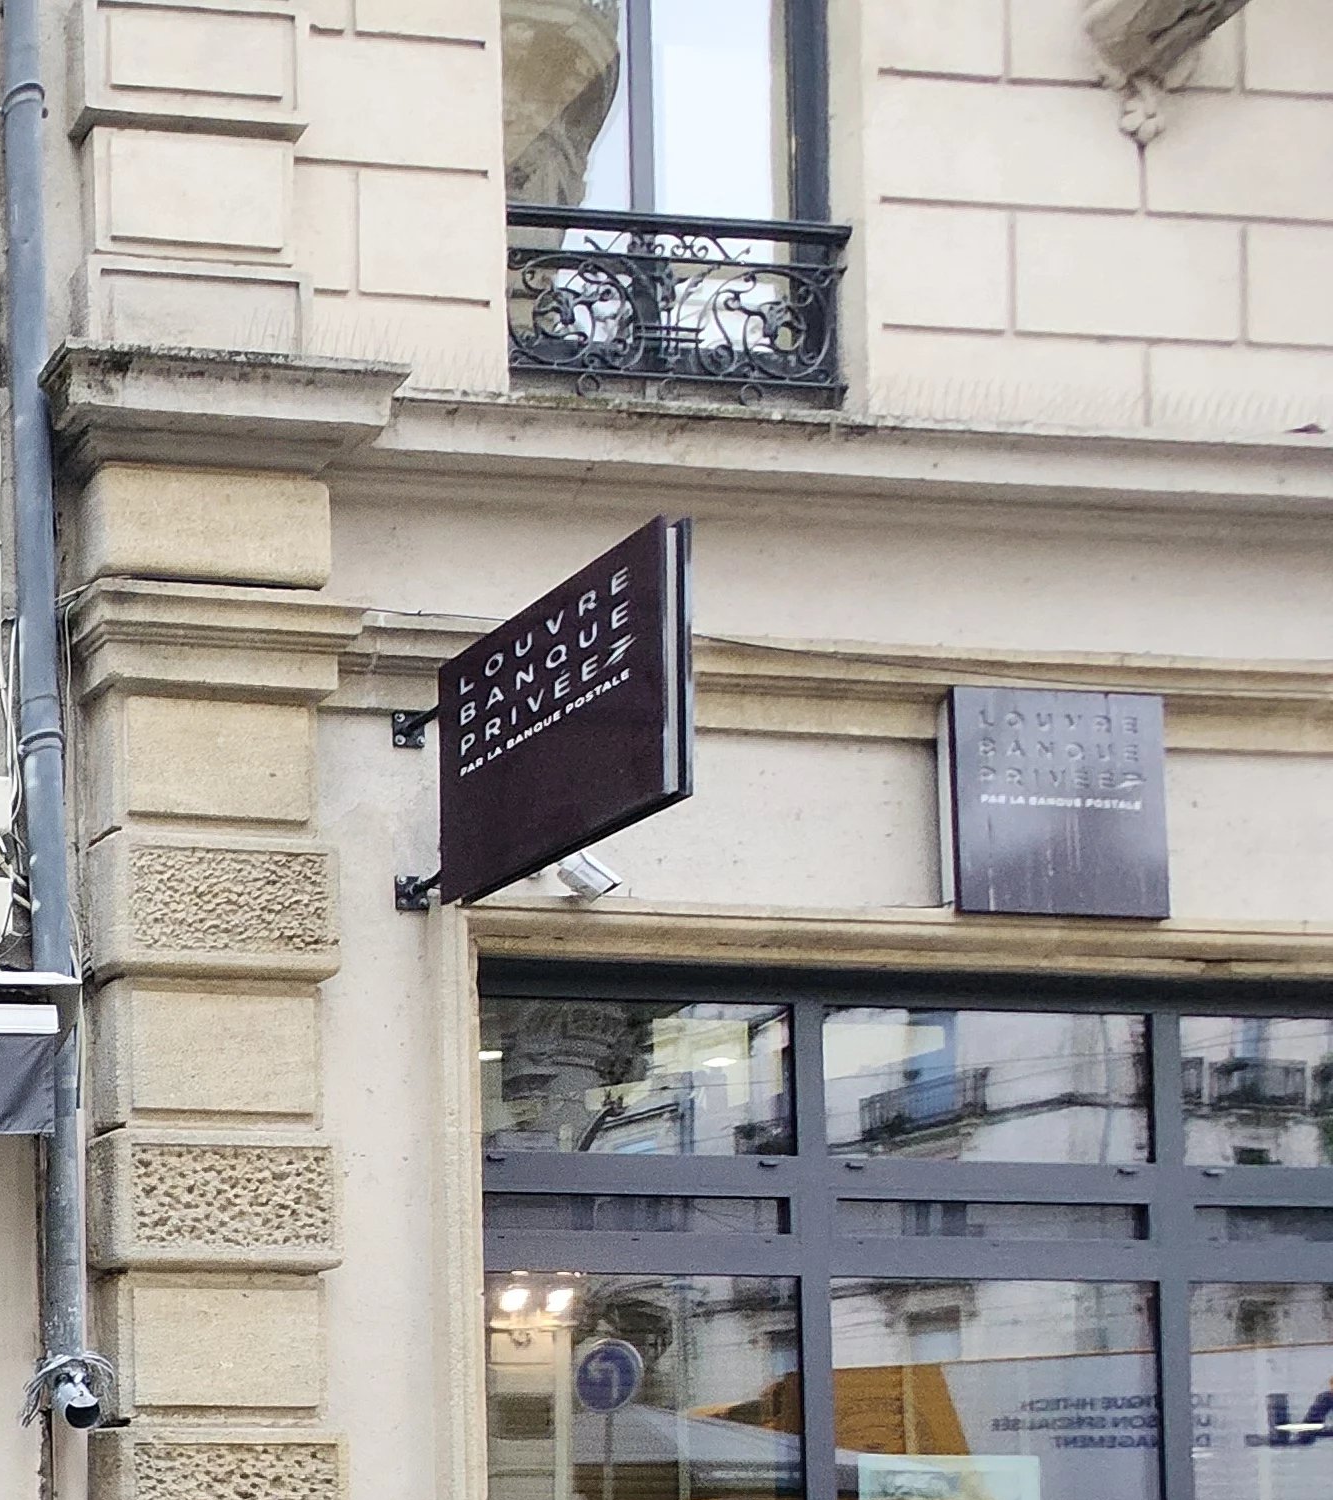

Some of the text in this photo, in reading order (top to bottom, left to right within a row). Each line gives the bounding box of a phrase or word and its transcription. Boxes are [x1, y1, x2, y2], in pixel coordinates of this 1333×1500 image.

[459, 566, 630, 696] LOUVRE
[459, 600, 630, 727] BANQUE
[459, 654, 599, 758] PRIVÉE
[459, 667, 631, 777] PAR LA BANQUE POSTALE
[978, 736, 1140, 762] BANQUE
[979, 709, 1139, 734] LOUVRE
[980, 794, 1142, 811] PAR LA BANQUE POSTALE
